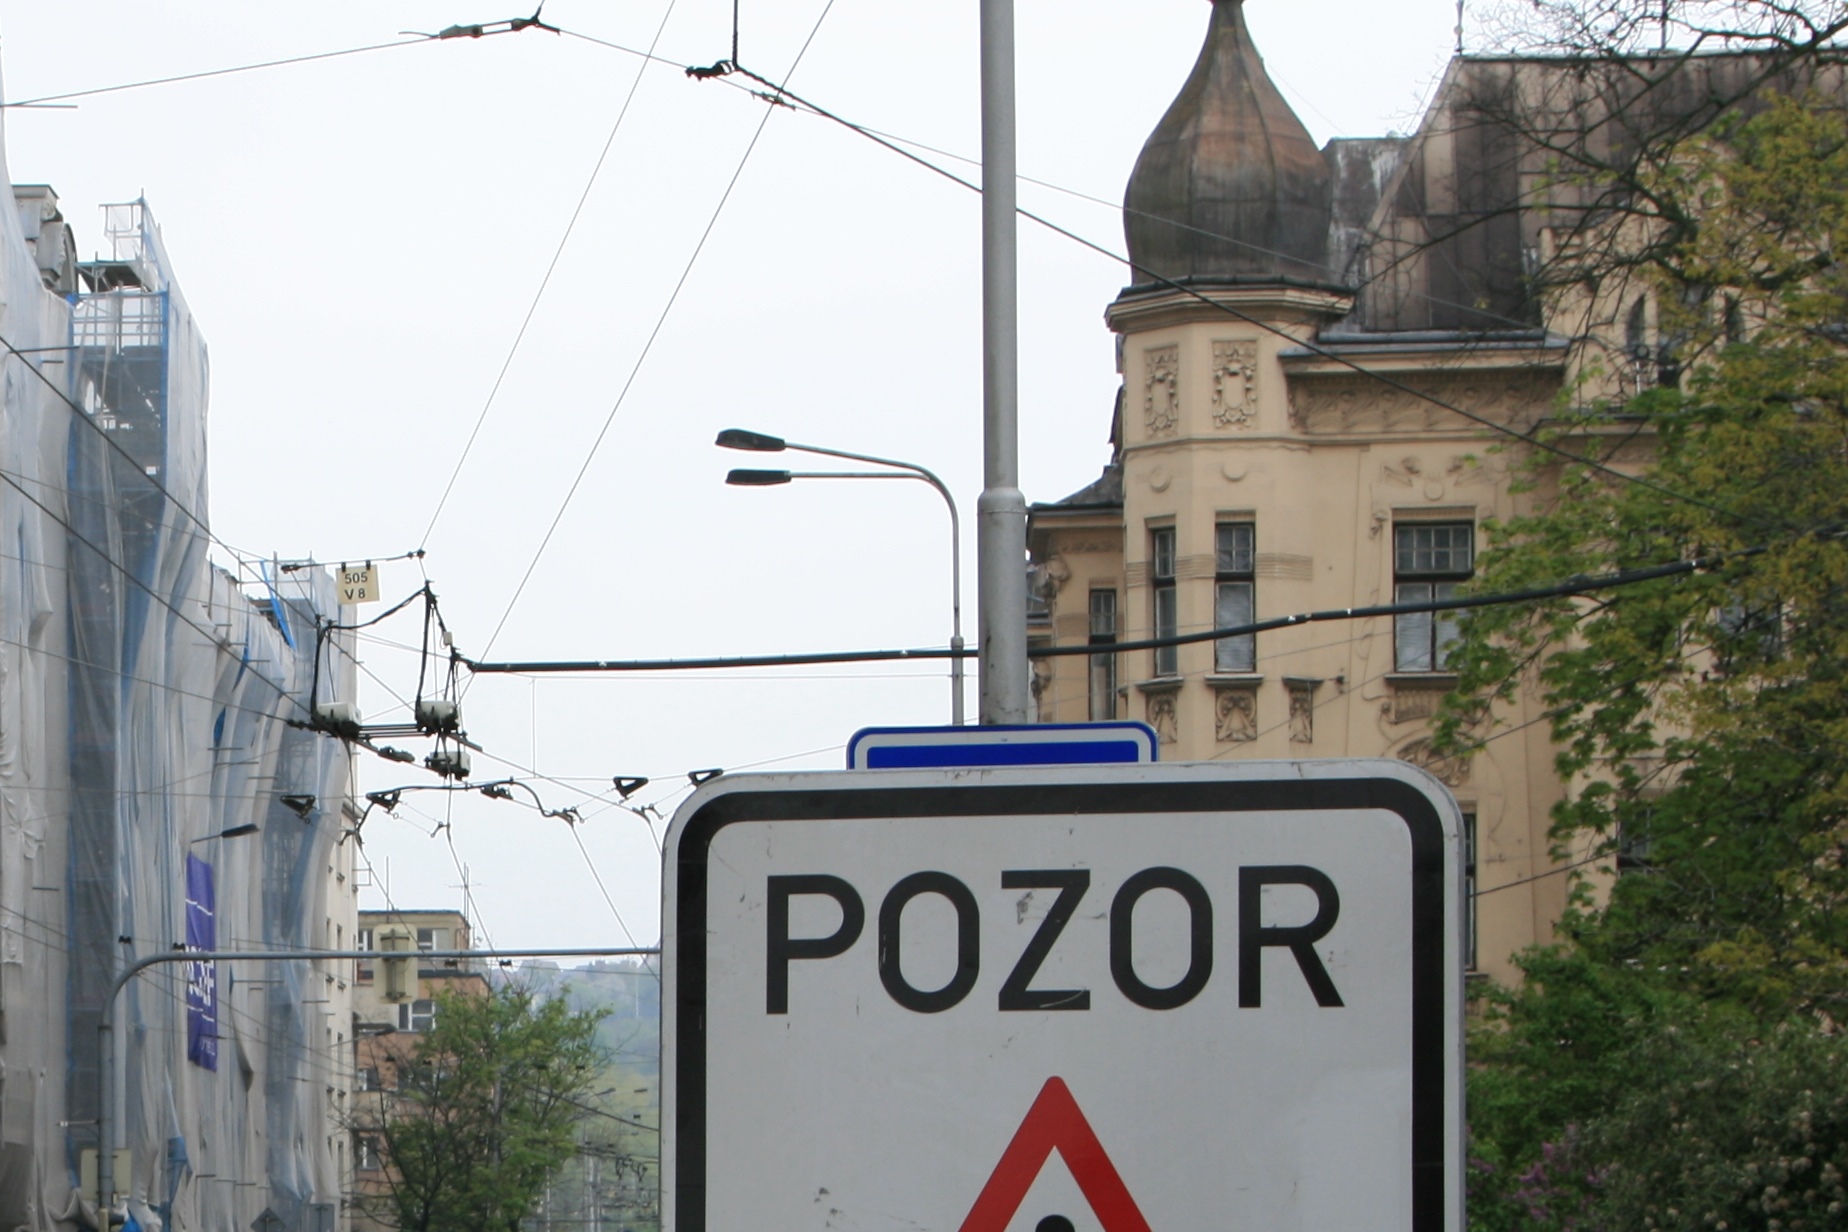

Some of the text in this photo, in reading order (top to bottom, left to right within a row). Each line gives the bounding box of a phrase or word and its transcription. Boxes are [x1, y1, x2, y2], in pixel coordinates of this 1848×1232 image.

[344, 572, 369, 585] 505
[344, 587, 366, 600] V 8
[766, 864, 1347, 1015] POZOR
